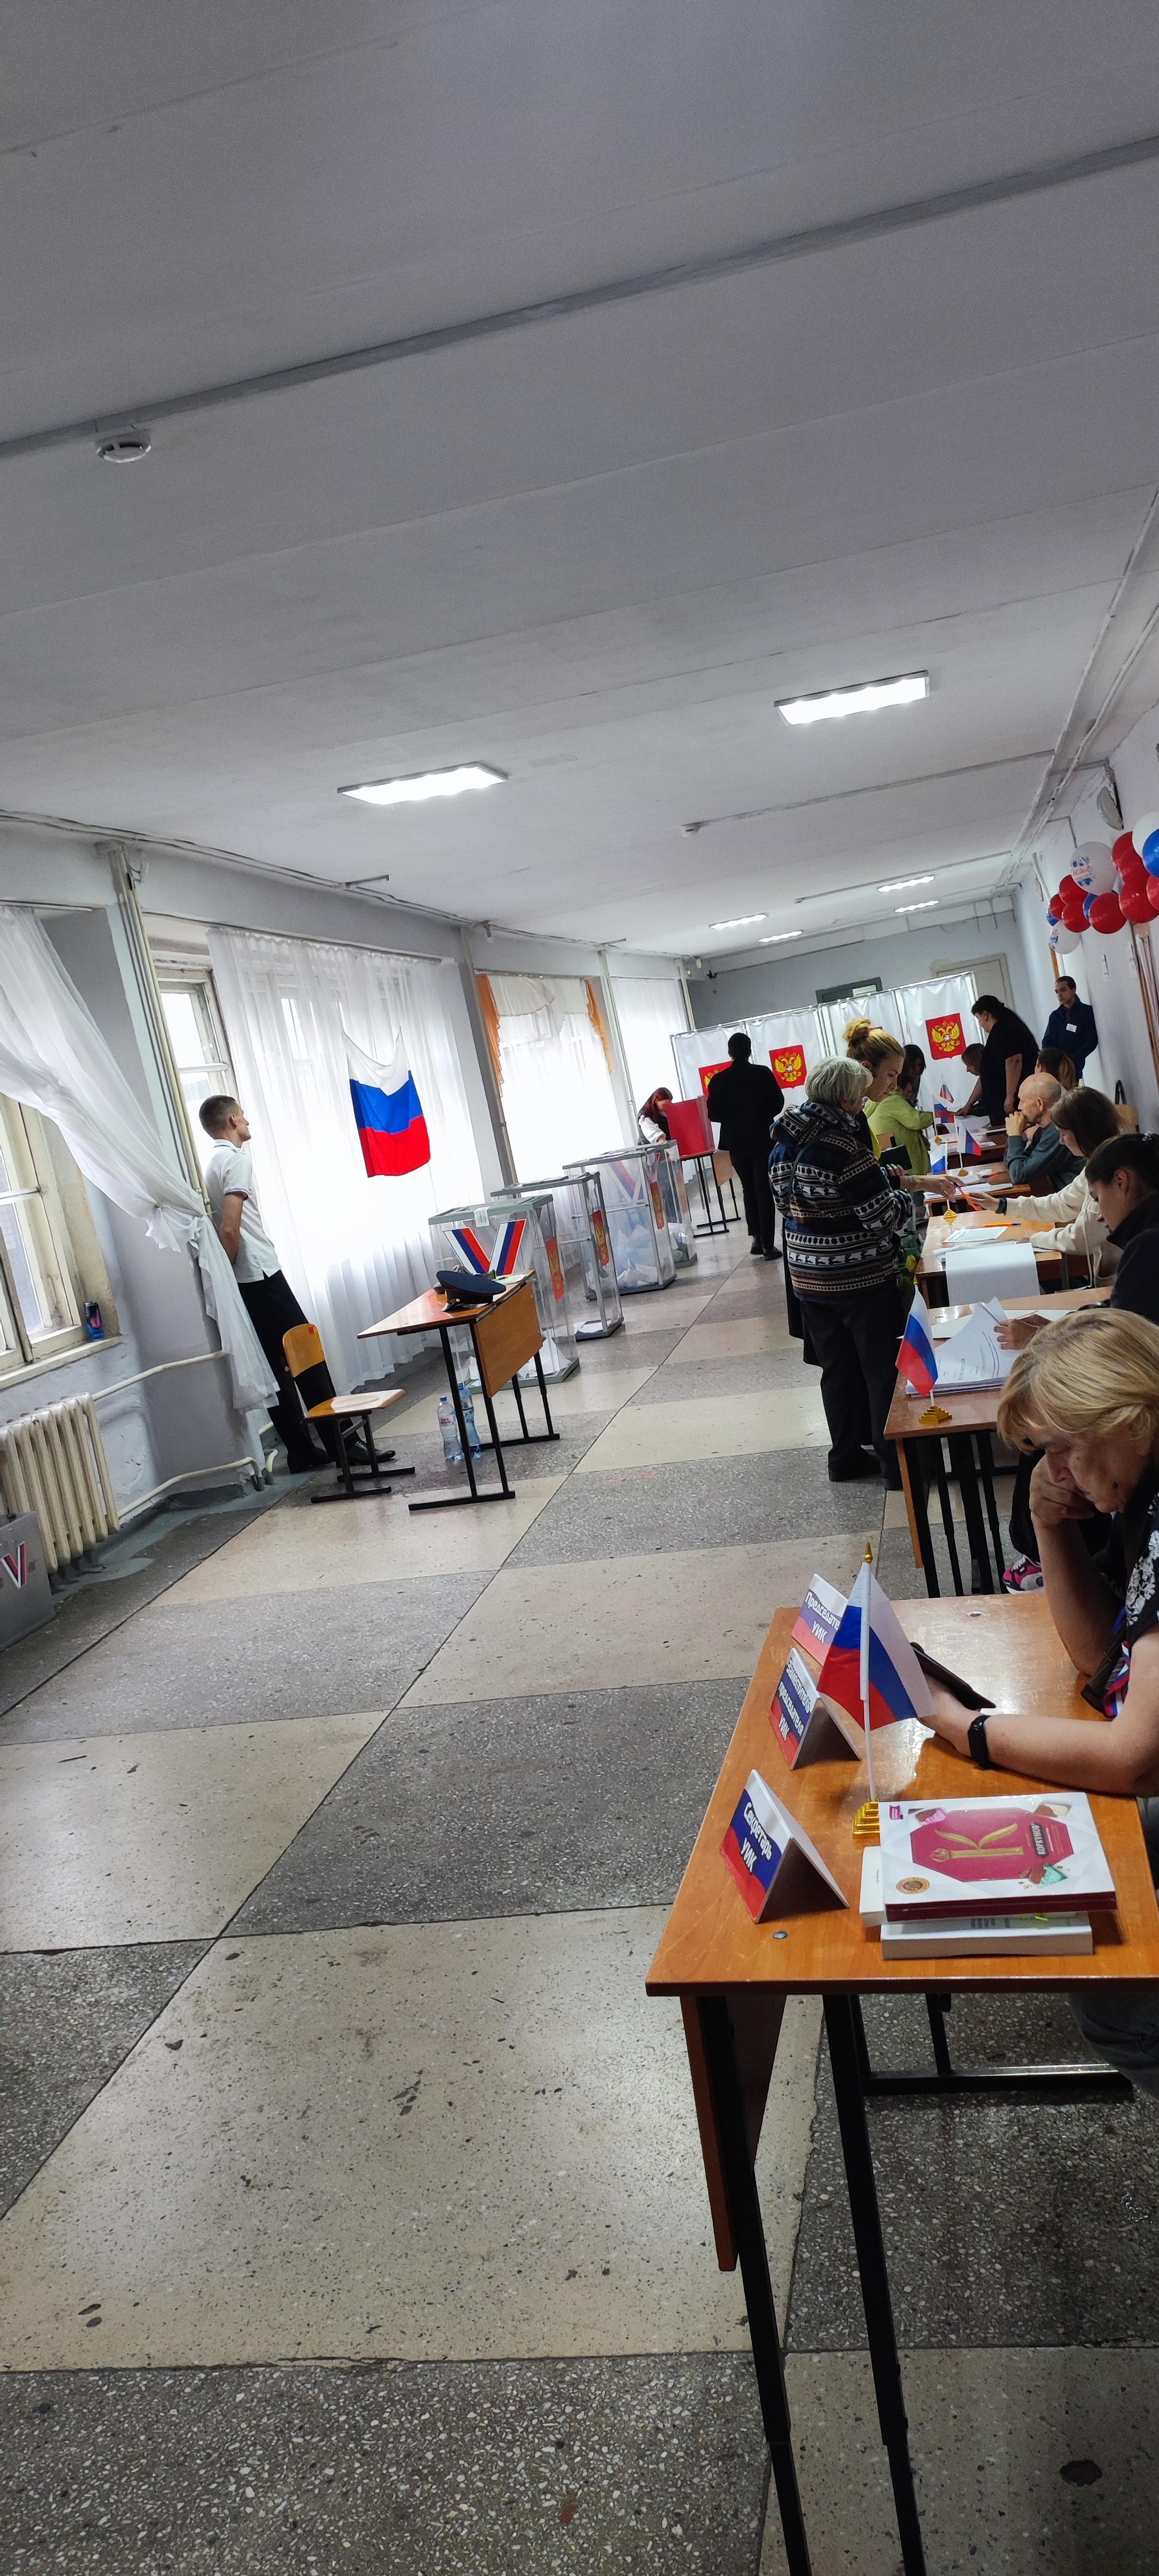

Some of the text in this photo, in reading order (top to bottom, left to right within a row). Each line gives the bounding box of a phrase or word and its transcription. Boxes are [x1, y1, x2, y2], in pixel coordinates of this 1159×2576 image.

[804, 1591, 841, 1631] Председате
[811, 1620, 828, 1643] УИК
[786, 1657, 811, 1714] Заместитель
[778, 1681, 804, 1737] председателя
[779, 1713, 789, 1741] УИК
[743, 1802, 772, 1861] Секретарь
[740, 1836, 757, 1873] УИК
